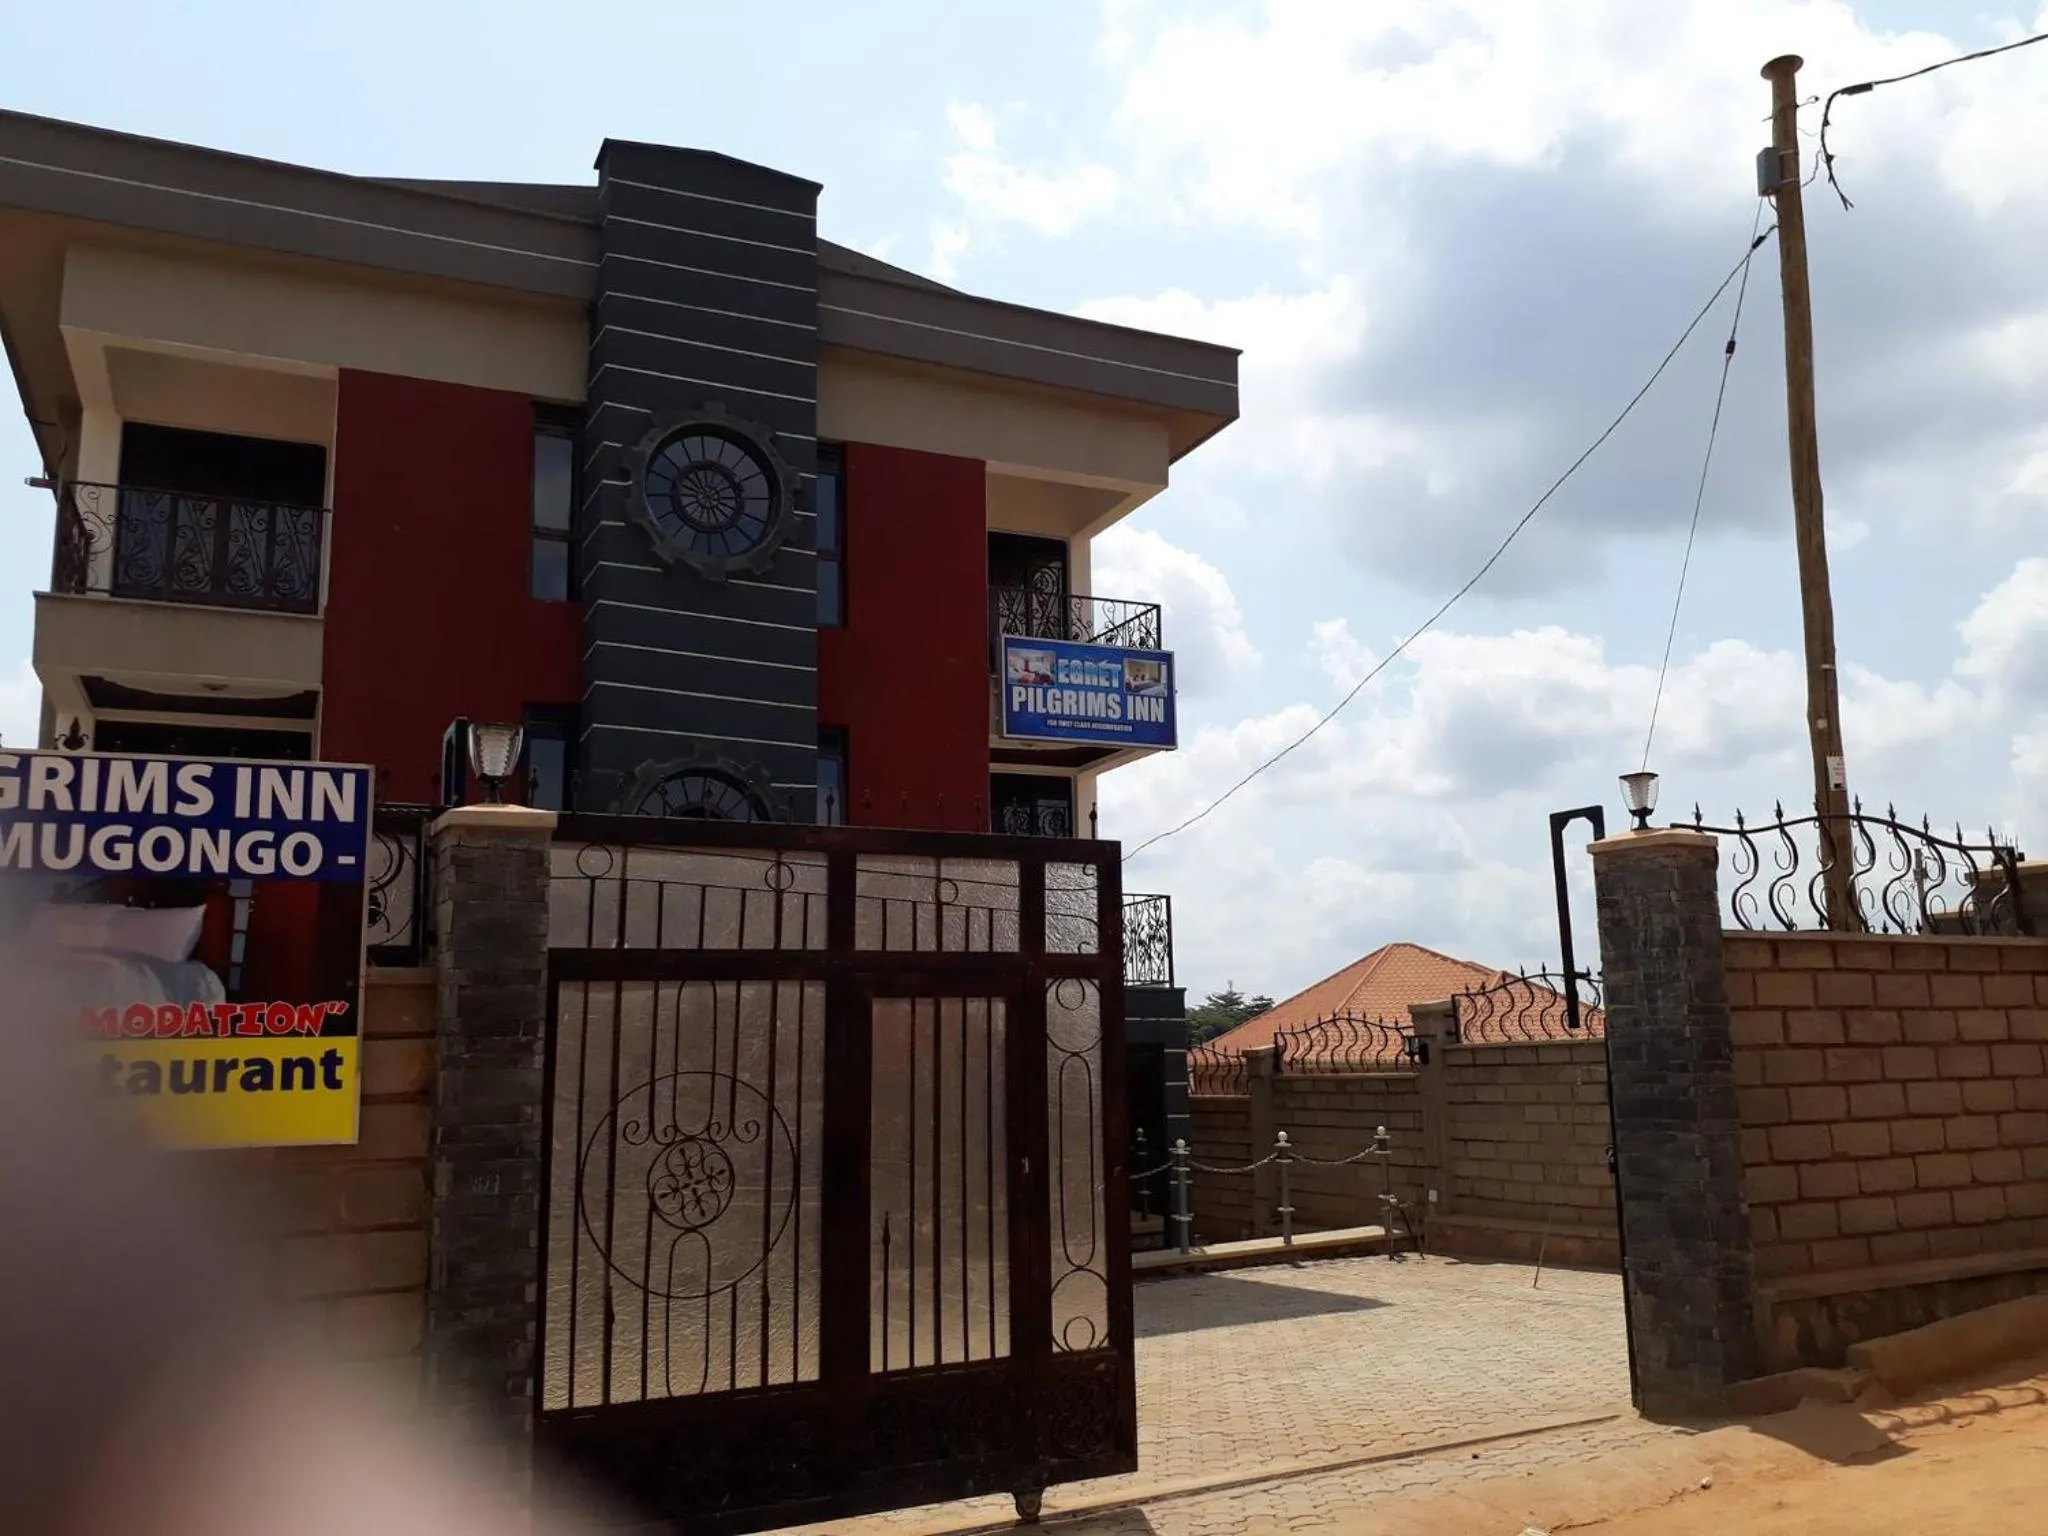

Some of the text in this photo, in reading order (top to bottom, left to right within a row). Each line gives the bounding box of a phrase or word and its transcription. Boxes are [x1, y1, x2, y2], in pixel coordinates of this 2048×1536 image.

[1012, 686, 1165, 723] PILGRIMS INN
[234, 766, 357, 823] INN
